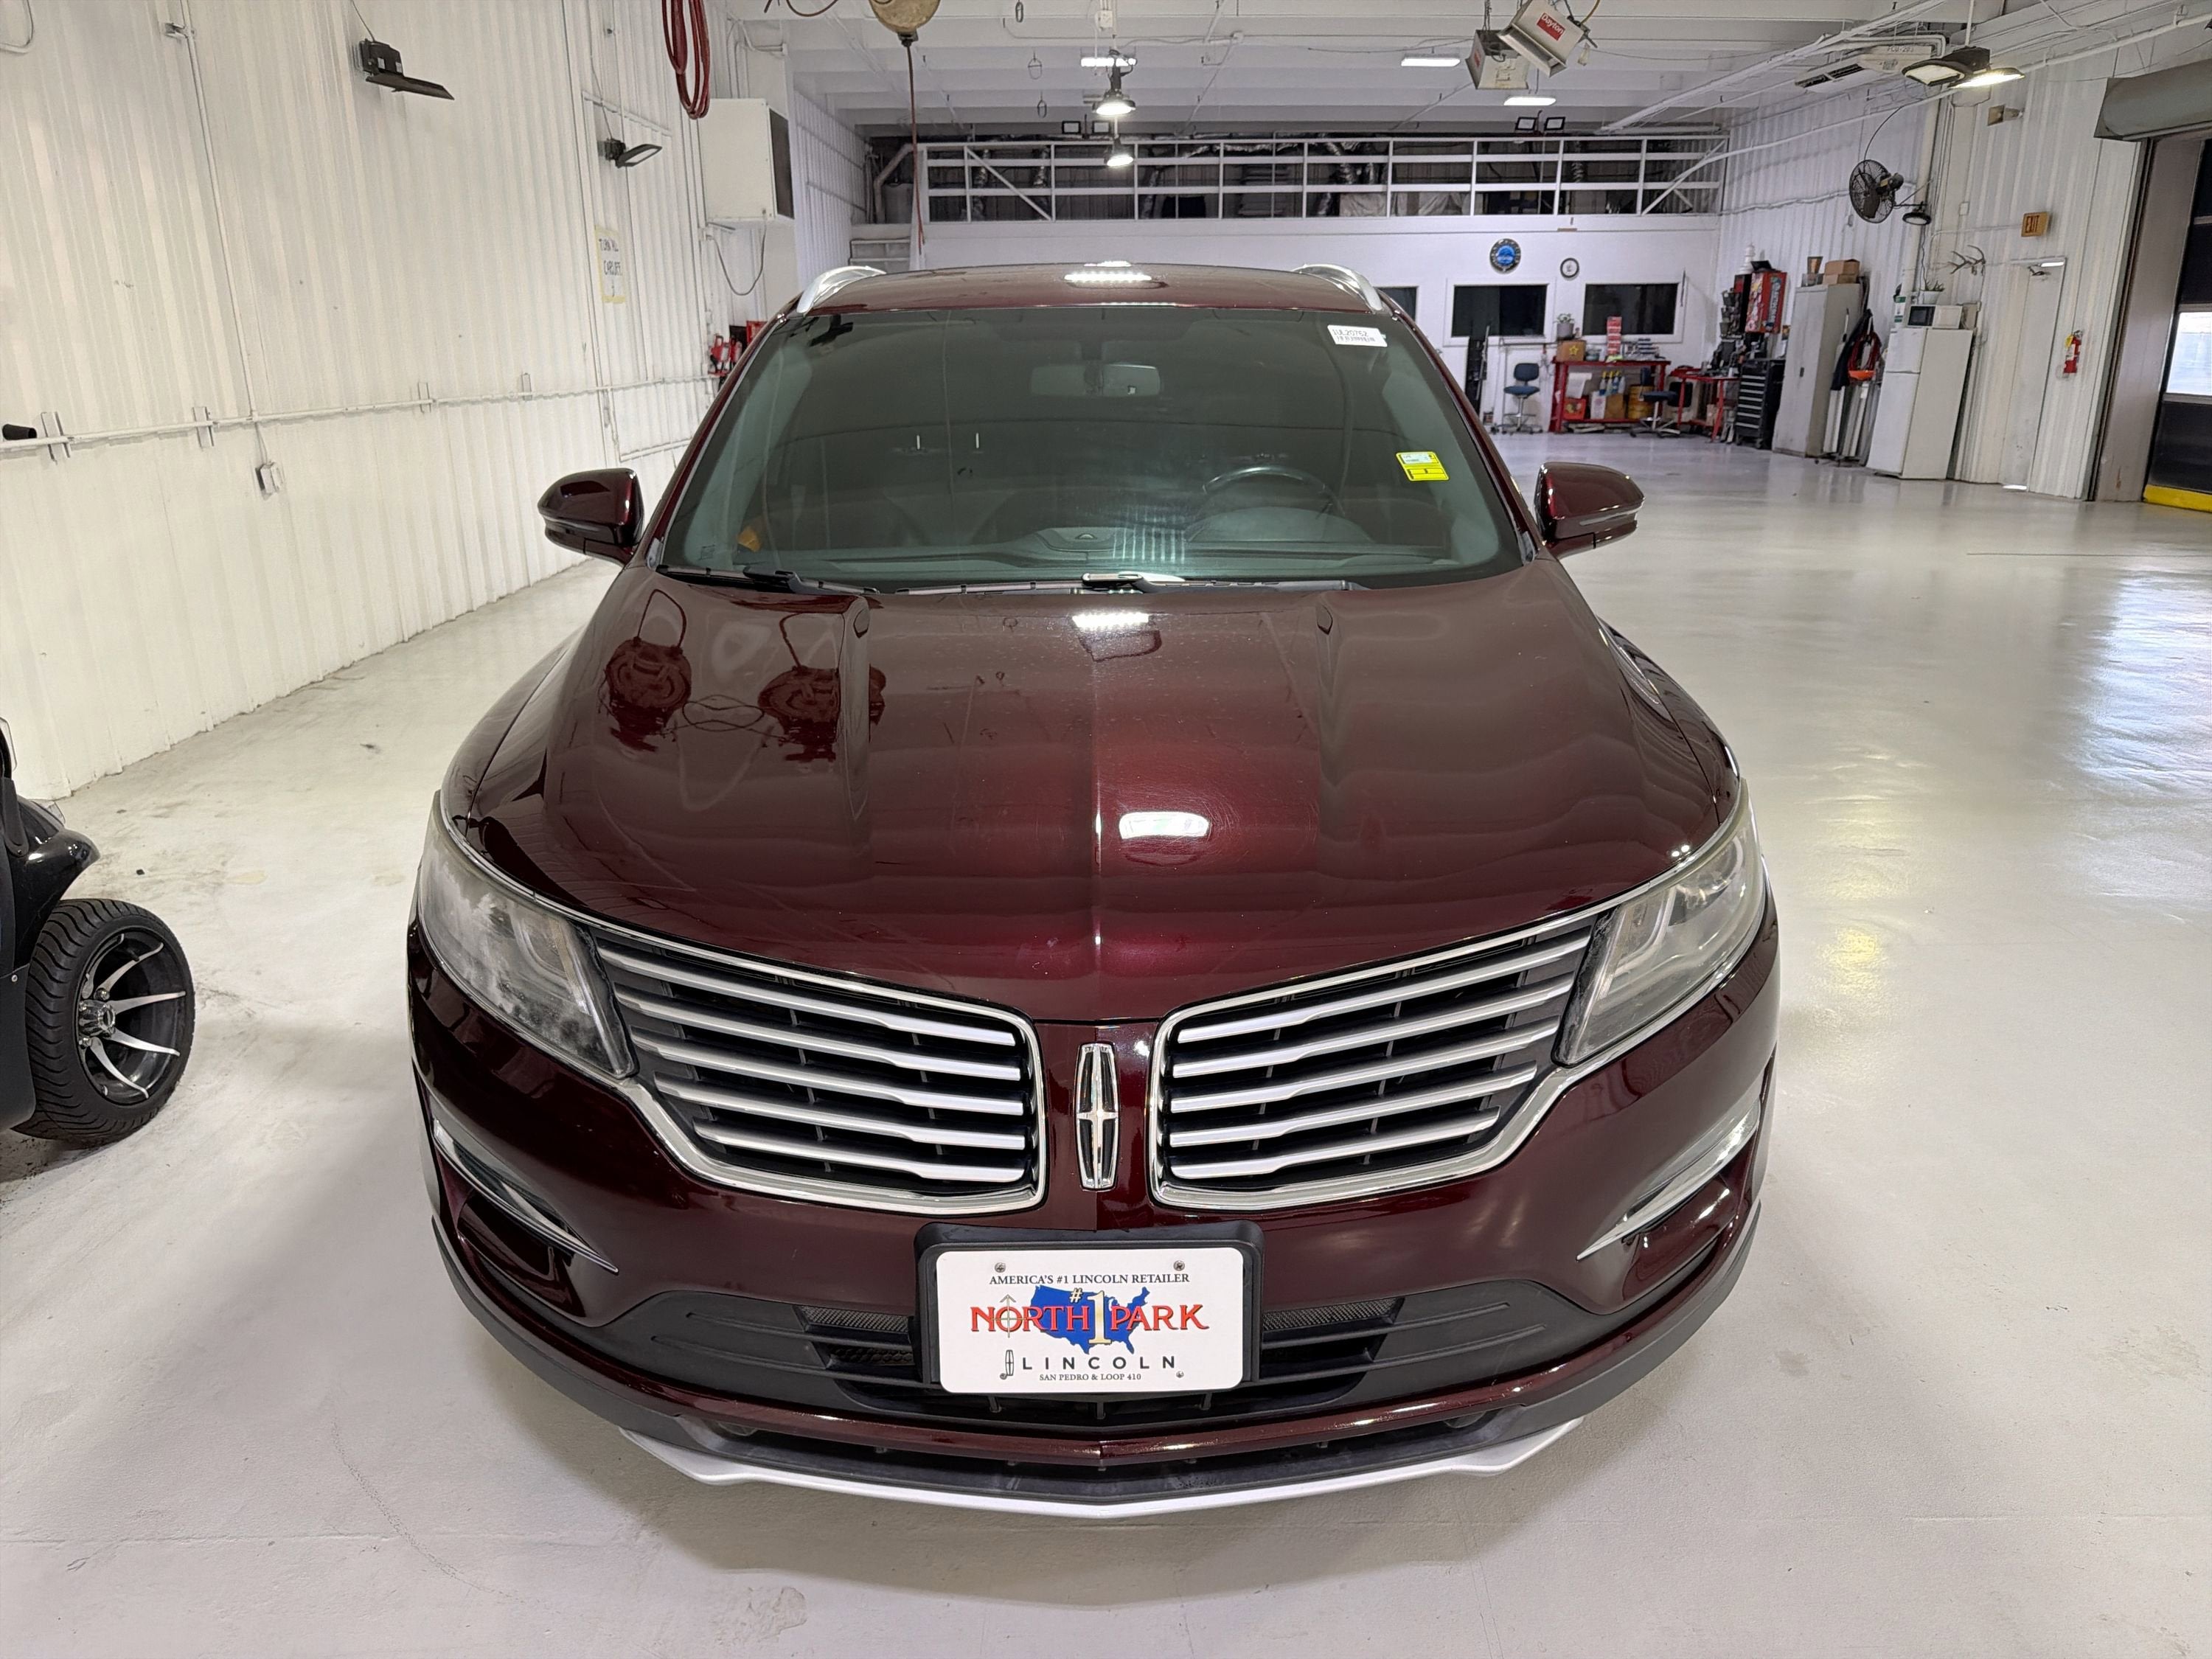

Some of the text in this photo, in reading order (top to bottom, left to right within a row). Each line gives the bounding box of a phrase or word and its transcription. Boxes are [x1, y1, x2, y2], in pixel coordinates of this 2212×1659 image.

[1541, 13, 1564, 35] Dayton
[2025, 215, 2039, 233] EXIT
[1056, 1275, 1068, 1284] #1
[1072, 1274, 1128, 1284] LINCOLN
[1132, 1273, 1190, 1283] RETAILER
[970, 1305, 1090, 1332] NORTH
[1110, 1304, 1210, 1332] PARK
[1022, 1355, 1175, 1371] LINCOLN
